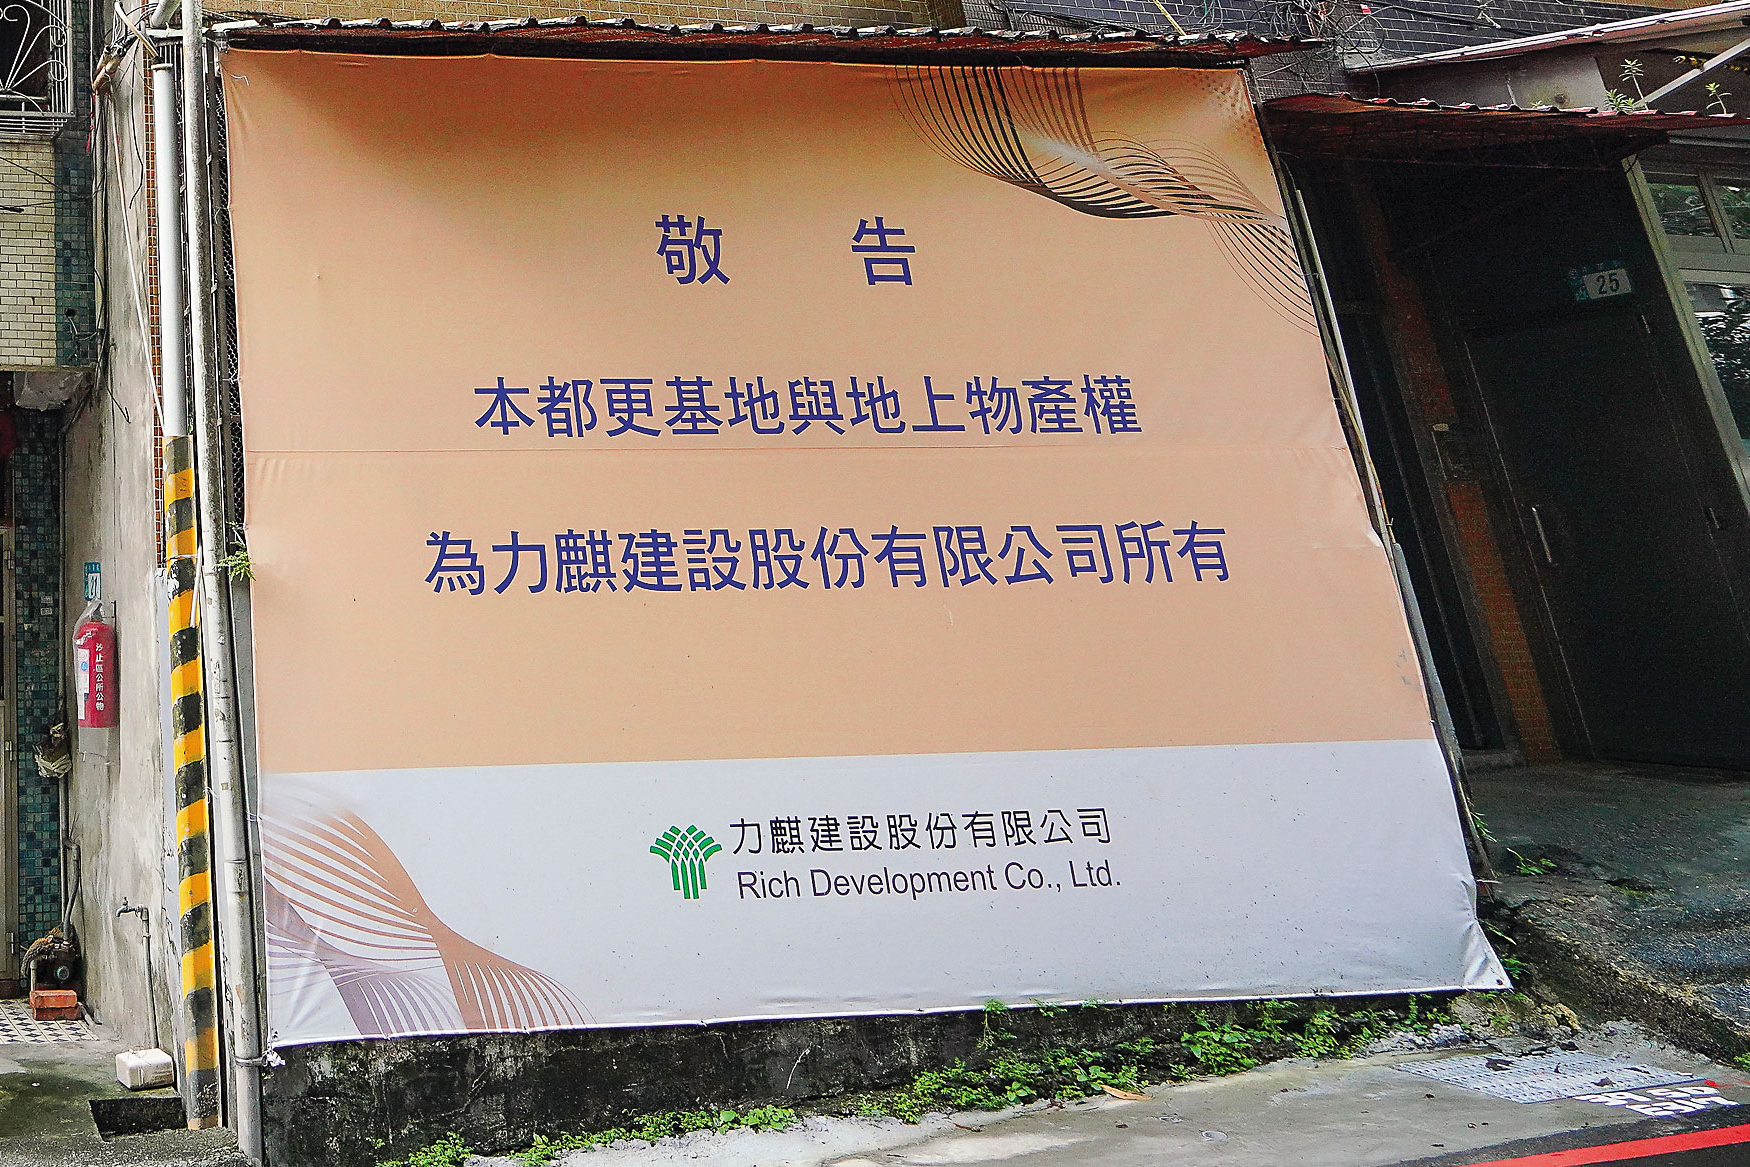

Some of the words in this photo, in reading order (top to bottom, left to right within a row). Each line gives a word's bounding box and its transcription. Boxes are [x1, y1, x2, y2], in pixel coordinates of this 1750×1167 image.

[1596, 272, 1620, 295] 25
[474, 374, 1144, 438] 本都更基地與地上物產權
[424, 520, 1231, 596] 為力麒建設股份有限公司所有
[95, 642, 105, 711] 汐止區公所公物
[729, 807, 1112, 856] 力麒建設股份有限公司
[736, 870, 801, 900] Rich
[809, 863, 998, 901] Development
[1004, 860, 1062, 893] Co.,
[1067, 858, 1122, 888] Ltd.
